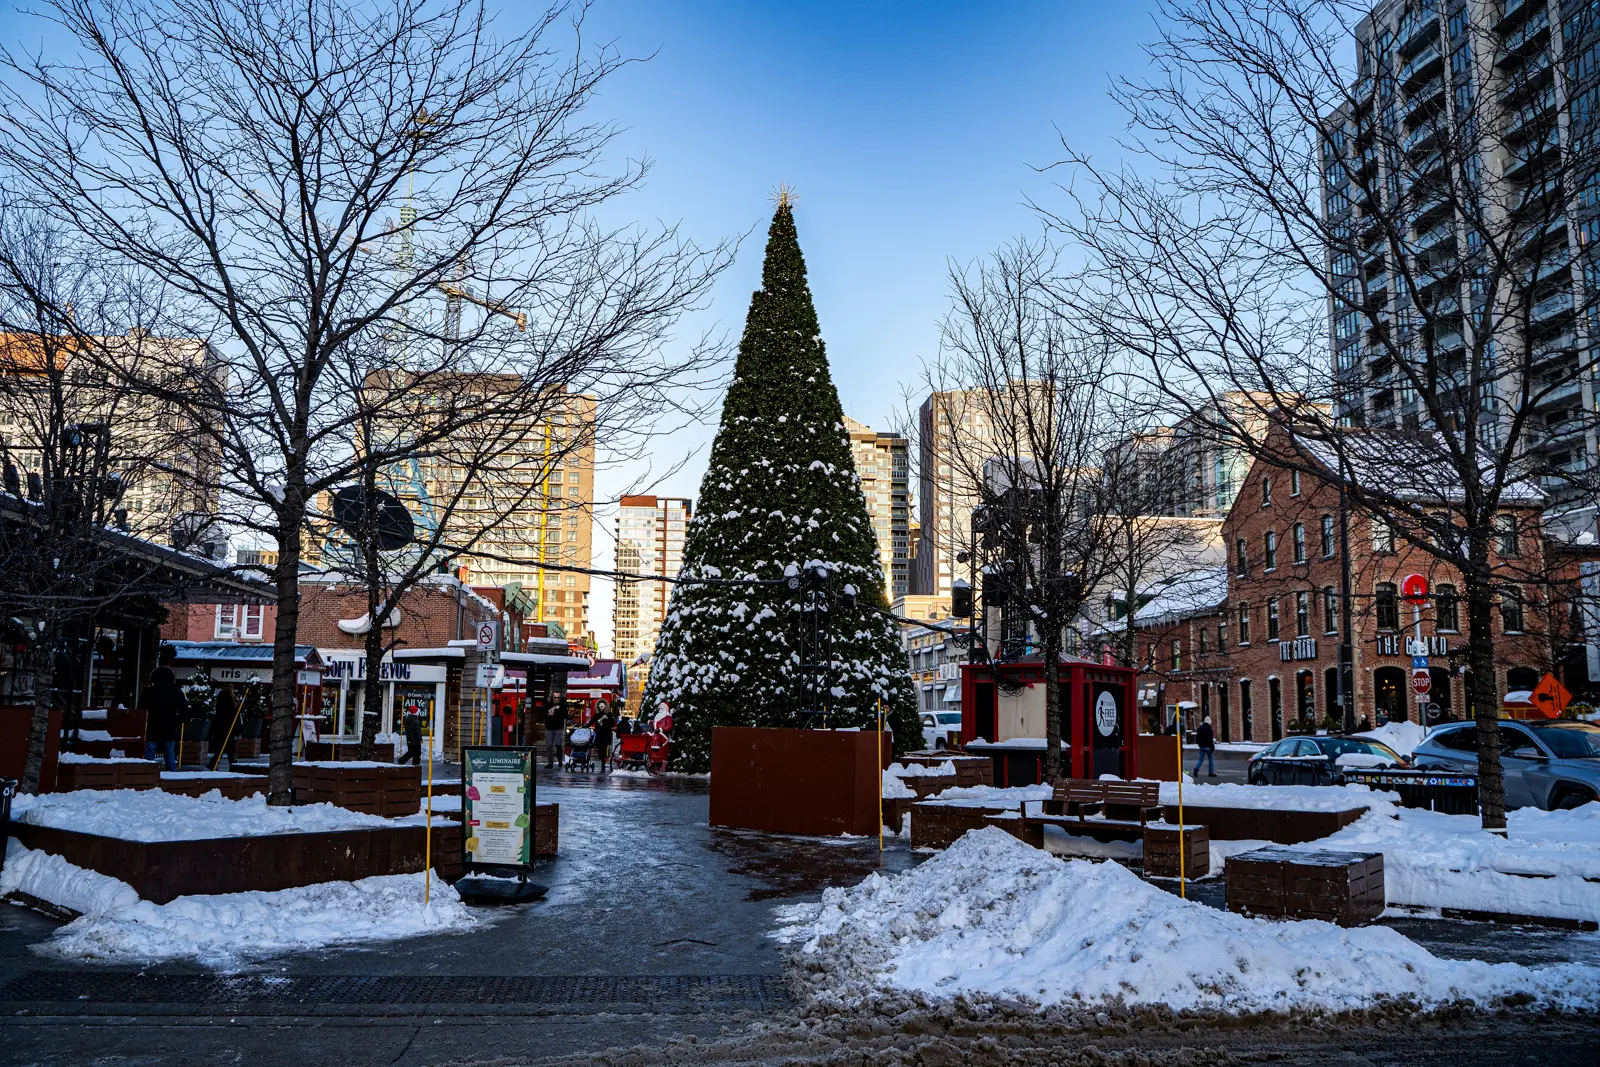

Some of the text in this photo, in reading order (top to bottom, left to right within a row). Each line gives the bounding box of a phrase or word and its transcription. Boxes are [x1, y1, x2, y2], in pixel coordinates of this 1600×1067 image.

[1279, 638, 1316, 661] THE GRAND
[1376, 635, 1447, 656] THE GAND
[221, 668, 241, 679] iris
[358, 657, 411, 680] FEVOG
[1413, 677, 1430, 688] STOP
[405, 699, 416, 708] All
[1104, 708, 1115, 718] FREE
